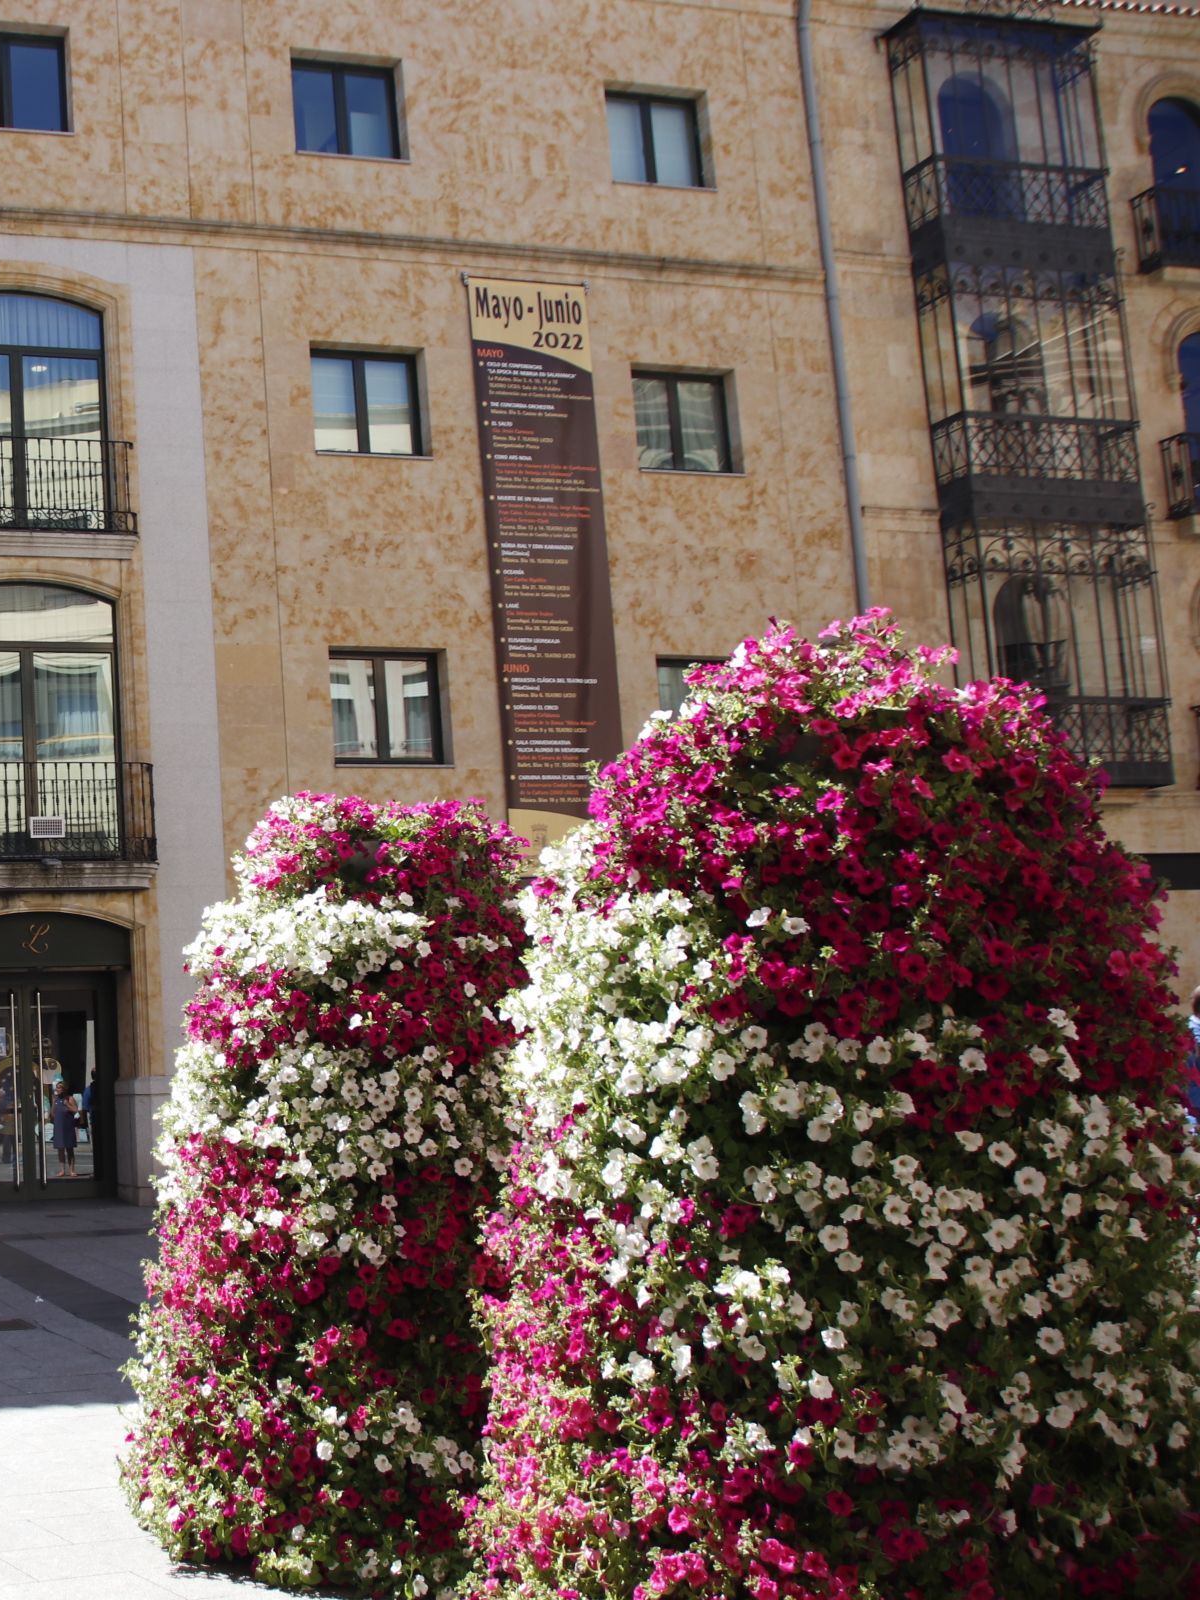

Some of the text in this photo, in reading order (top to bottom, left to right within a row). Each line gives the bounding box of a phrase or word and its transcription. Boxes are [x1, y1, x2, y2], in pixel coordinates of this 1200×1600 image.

[475, 287, 523, 328] Mayo
[537, 291, 582, 330] Junio
[532, 331, 584, 350] 2022
[502, 664, 530, 672] JUNIO
